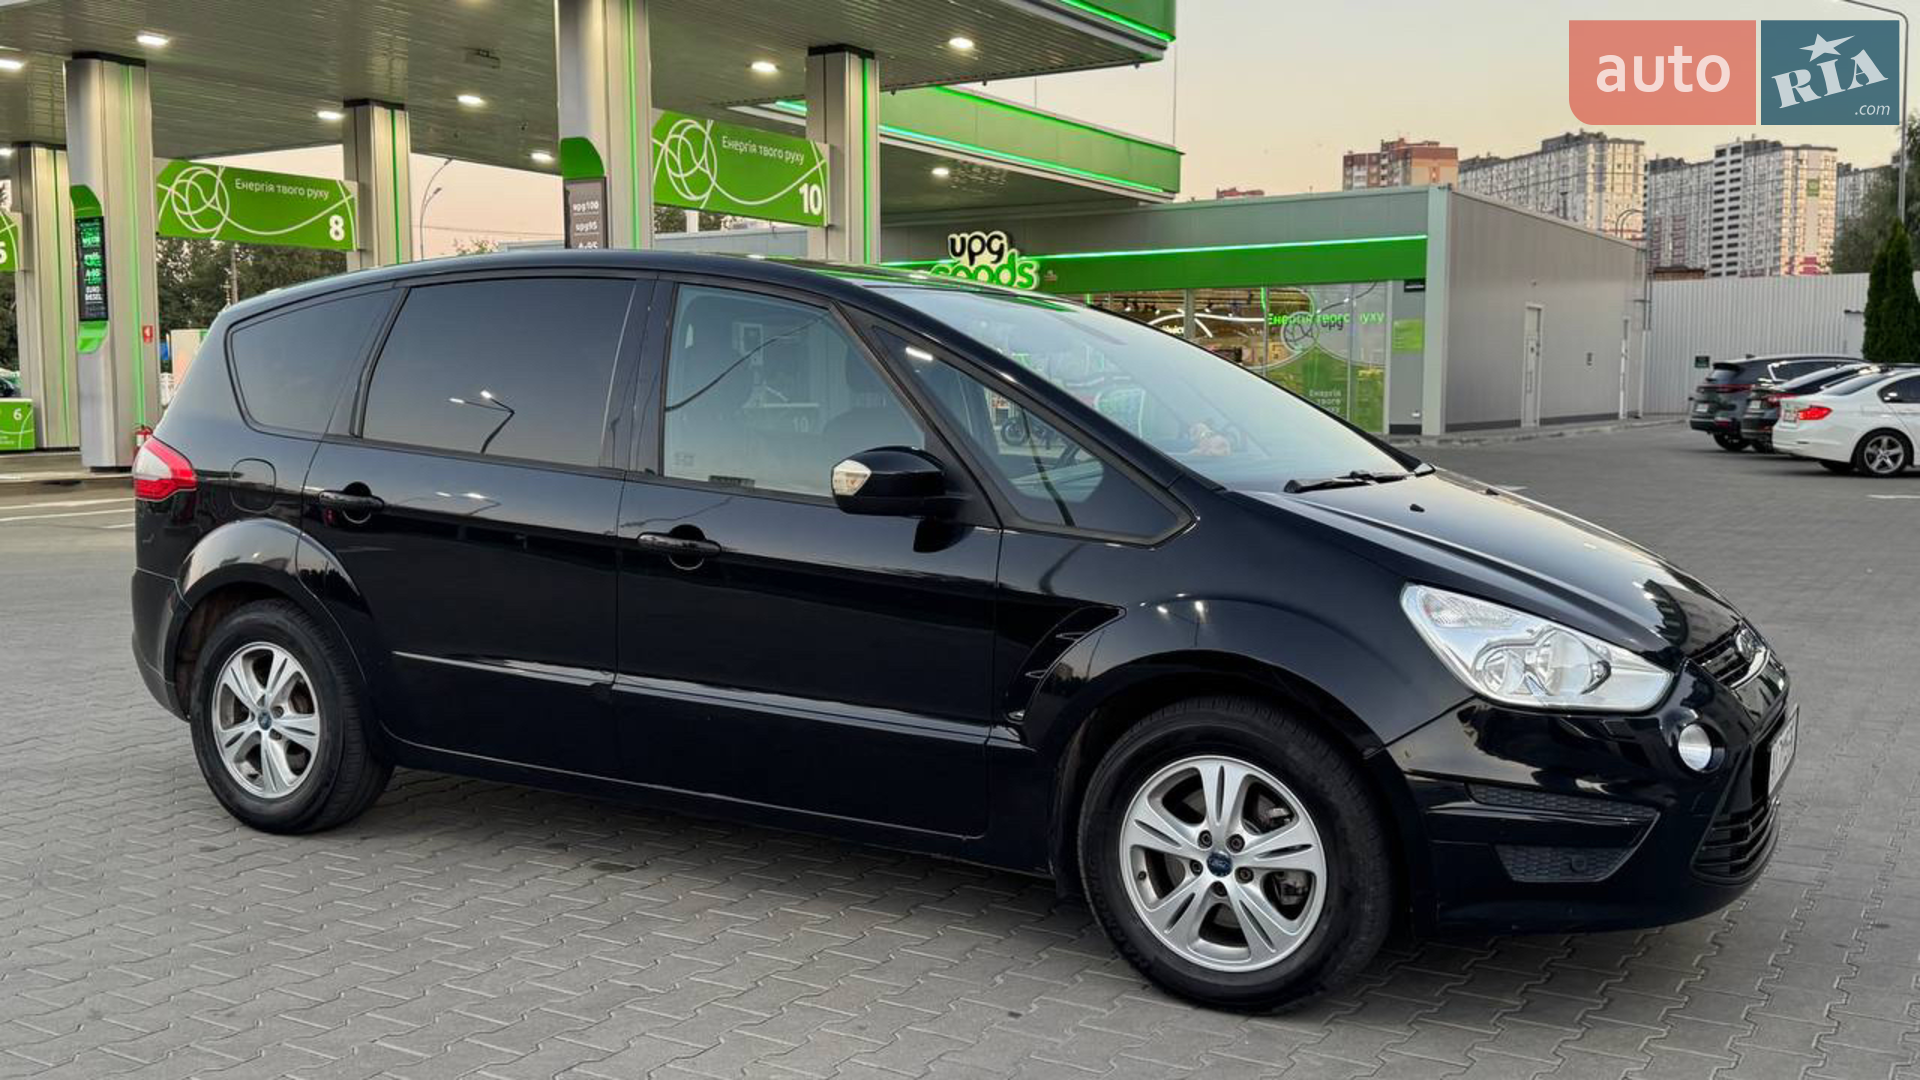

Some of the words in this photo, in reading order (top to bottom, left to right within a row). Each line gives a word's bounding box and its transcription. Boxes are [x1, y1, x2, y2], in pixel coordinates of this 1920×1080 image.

[722, 136, 757, 155] Енергія
[759, 145, 783, 160] твого
[784, 150, 804, 165] руху
[235, 178, 275, 193] Енергія
[276, 184, 305, 196] твого
[307, 188, 329, 200] руху
[799, 182, 823, 216] 10
[329, 215, 345, 241] 8
[949, 232, 1006, 267] upg
[929, 251, 1035, 288] oods
[13, 407, 23, 421] 6
